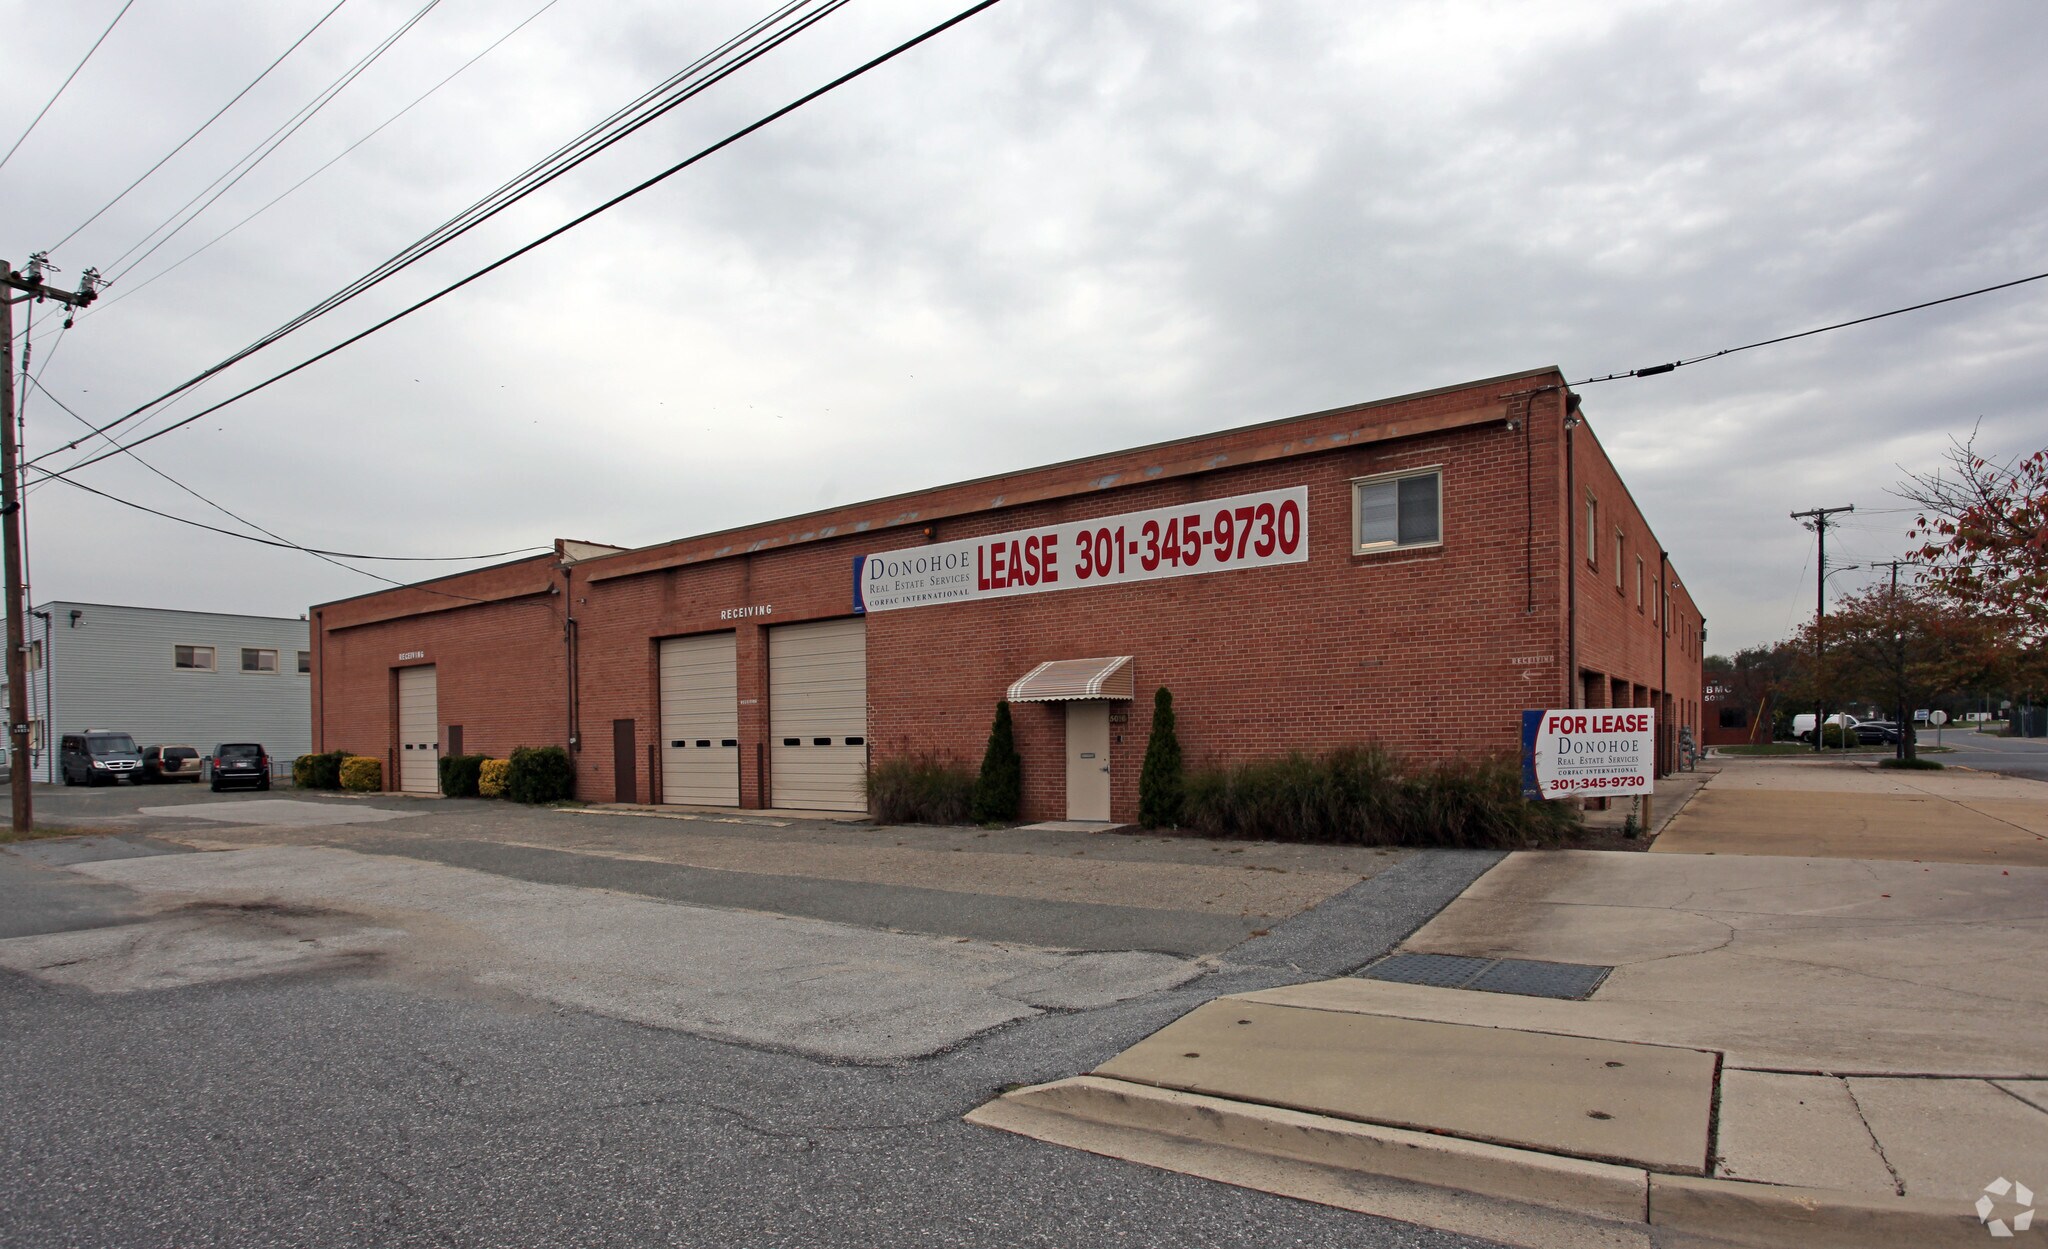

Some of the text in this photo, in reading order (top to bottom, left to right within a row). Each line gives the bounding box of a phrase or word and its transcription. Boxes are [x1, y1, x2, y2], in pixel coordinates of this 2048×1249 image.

[977, 499, 1300, 591] LEASE 301-345-9730
[870, 551, 970, 580] DONOHOE
[869, 573, 970, 594] REAL ESTATE SERVICES
[869, 588, 970, 606] CORFAC INTERNATIONAL
[720, 604, 772, 620] RECEIVING
[1511, 655, 1554, 664] RECEIVING
[1548, 714, 1648, 735] FOR LEASE
[1558, 737, 1639, 754] DONOHOE
[1557, 755, 1639, 765] REAL ESTATE SERVICES
[1550, 776, 1645, 790] 301-345-9730
